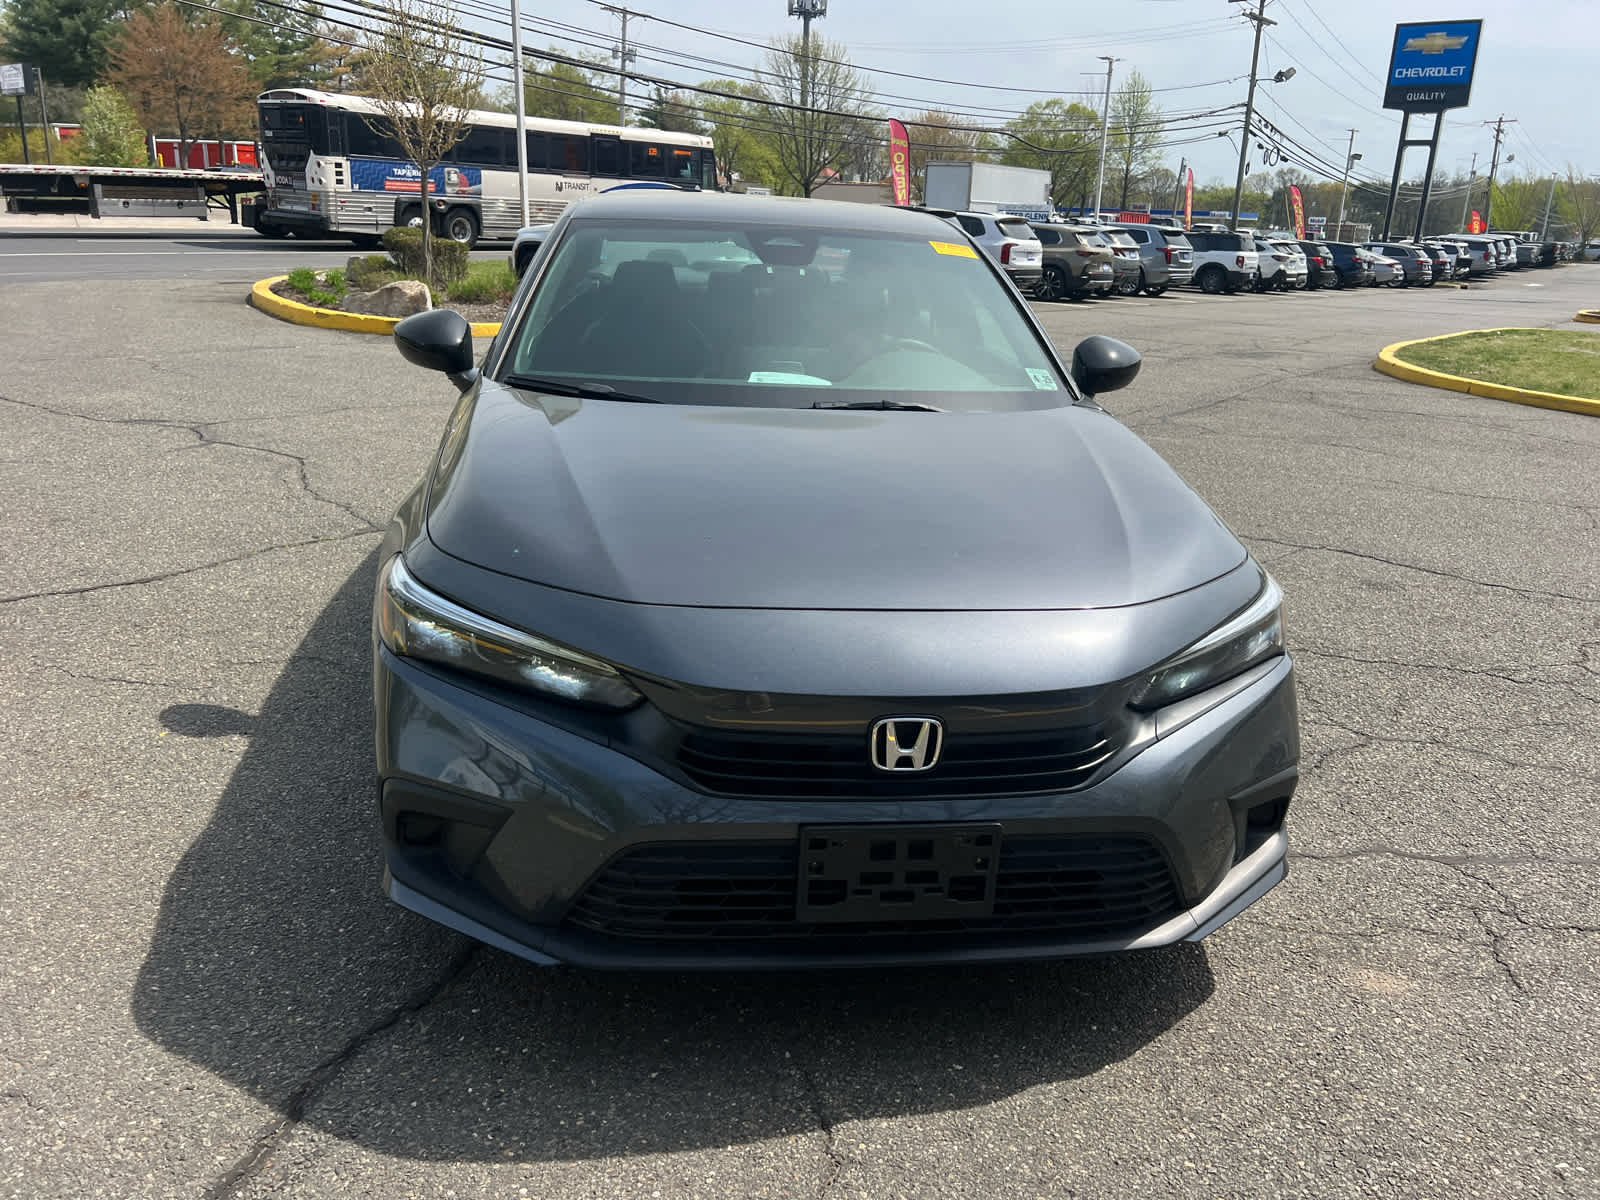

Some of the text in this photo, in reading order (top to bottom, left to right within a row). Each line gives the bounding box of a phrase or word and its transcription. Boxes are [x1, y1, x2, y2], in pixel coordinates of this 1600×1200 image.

[1395, 66, 1467, 78] CHEVROLET
[1406, 92, 1447, 101] QUALITY
[564, 182, 590, 191] TRANSIT
